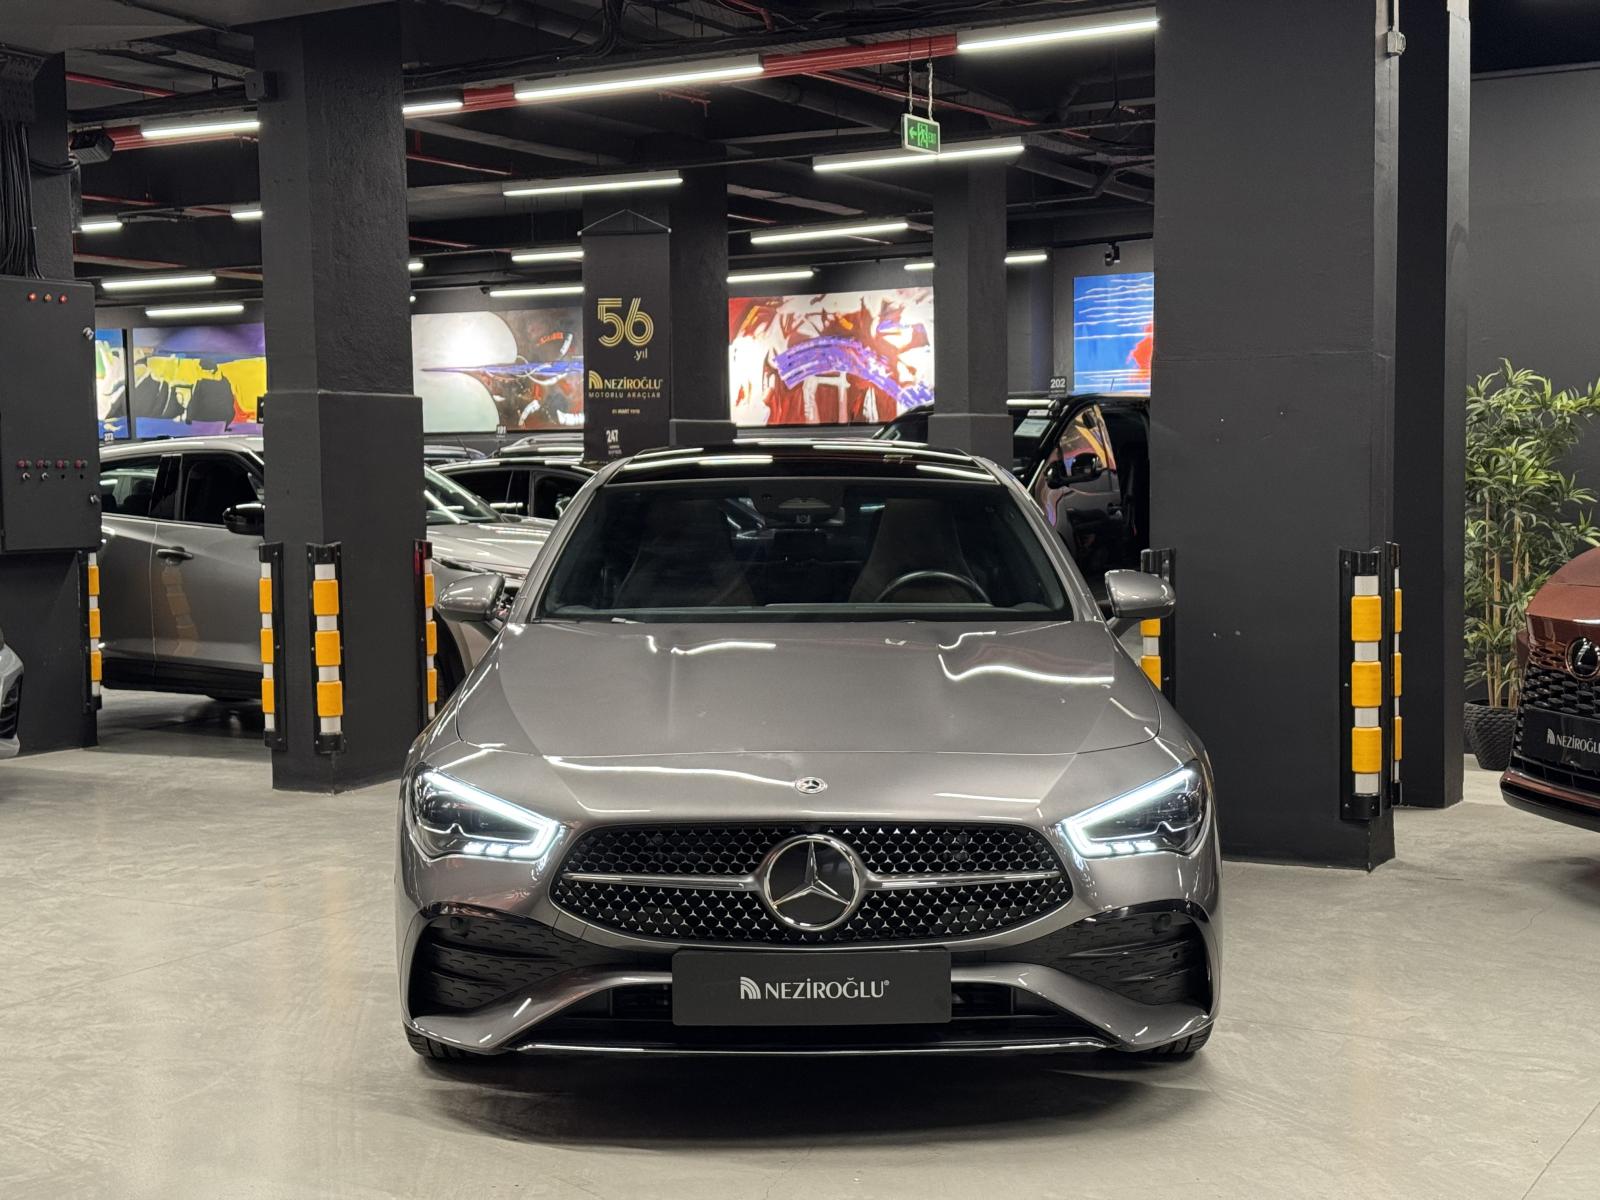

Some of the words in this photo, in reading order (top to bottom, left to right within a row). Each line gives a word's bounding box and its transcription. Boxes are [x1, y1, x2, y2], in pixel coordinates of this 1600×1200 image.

[597, 297, 655, 347] 56
[1050, 378, 1066, 389] 202
[626, 391, 661, 399] ARAÇLAR
[606, 429, 619, 443] 247
